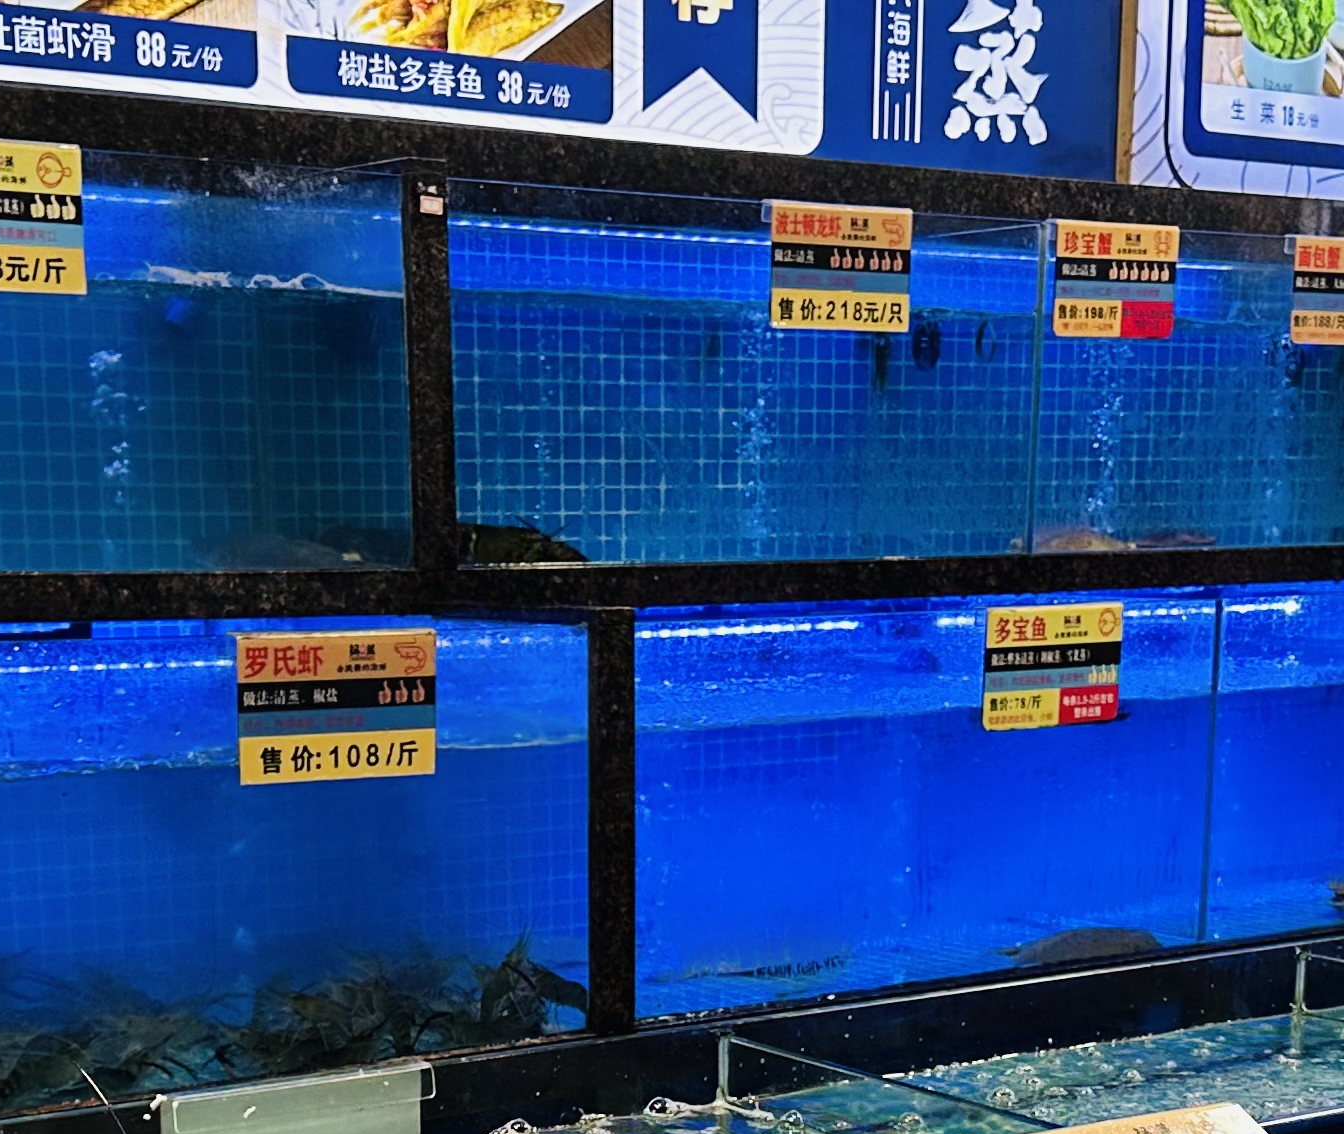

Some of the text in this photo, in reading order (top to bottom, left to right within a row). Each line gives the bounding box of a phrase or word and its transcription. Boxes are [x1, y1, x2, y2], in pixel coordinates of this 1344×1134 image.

[886, 0, 912, 84] 海鲜
[338, 50, 486, 100] 椒盐多春鱼
[1063, 231, 1113, 256] 珍宝蟹
[1298, 244, 1341, 269] 面包蟹
[994, 615, 1048, 645] 多宝鱼
[243, 645, 325, 679] 罗氏虾
